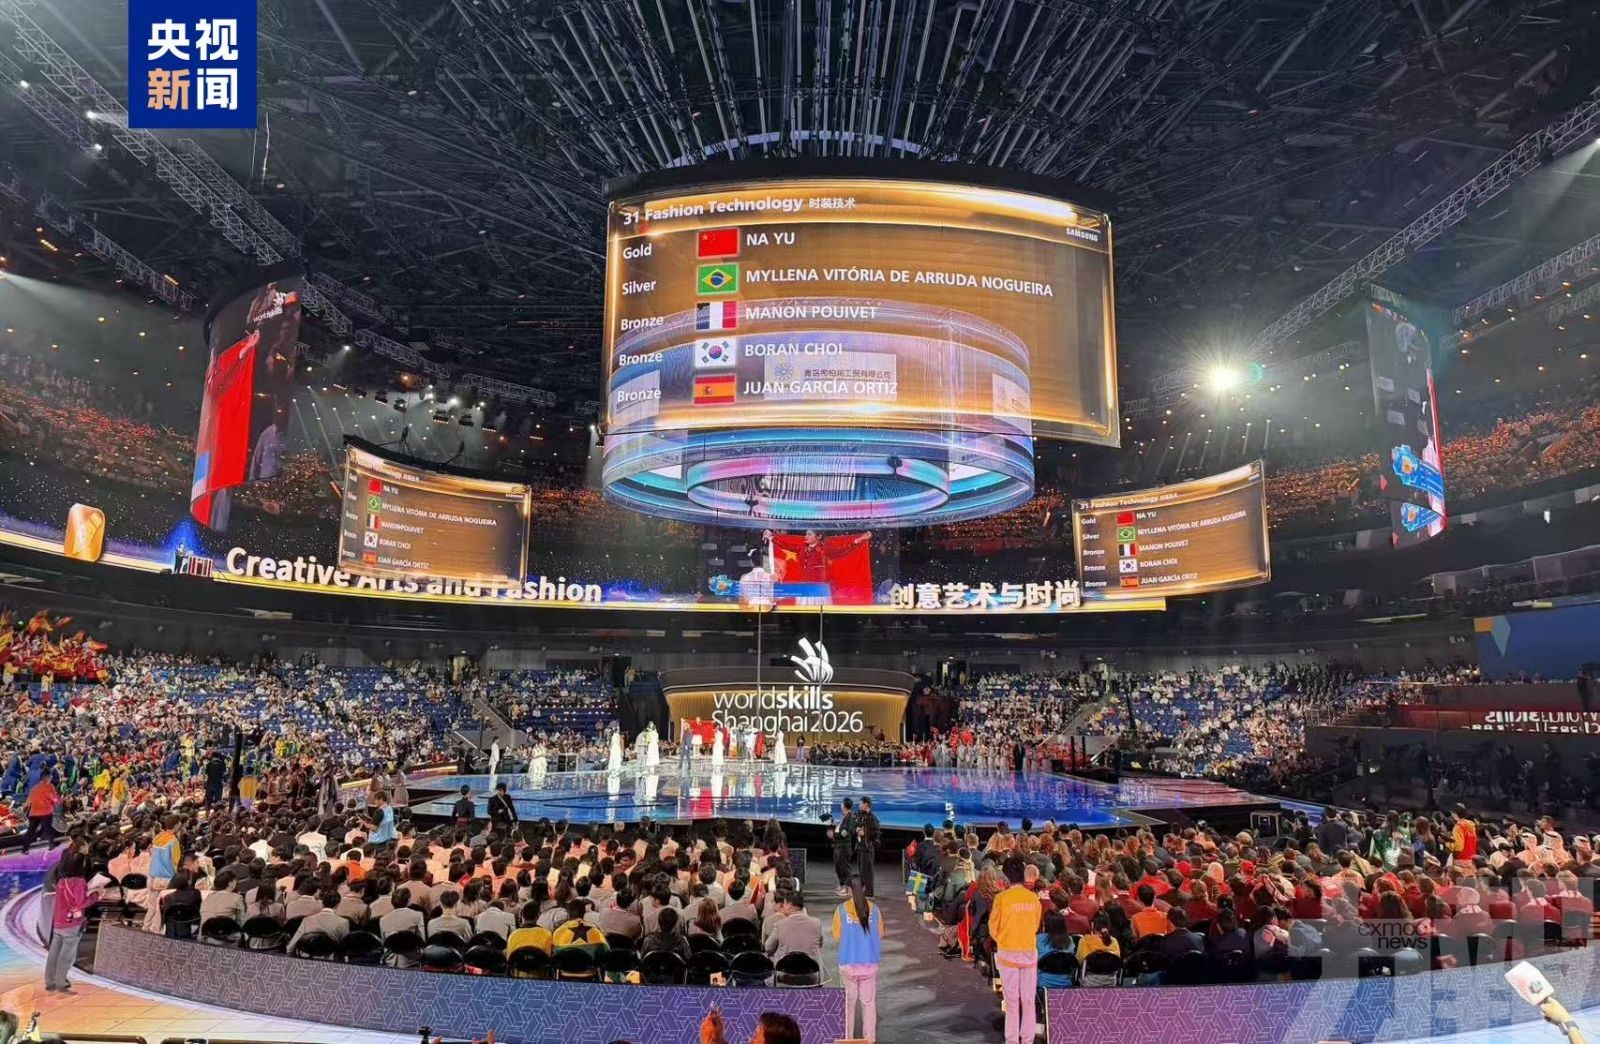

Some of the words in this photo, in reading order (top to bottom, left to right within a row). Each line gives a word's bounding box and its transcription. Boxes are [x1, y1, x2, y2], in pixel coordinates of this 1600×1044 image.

[623, 211, 640, 225] 31
[645, 204, 704, 221] Fashion
[709, 196, 803, 214] Technology
[746, 233, 769, 246] NA
[773, 232, 795, 245] YU
[1066, 227, 1098, 242] SAMSUNG
[622, 244, 652, 260] Gold
[622, 279, 657, 295] Silver
[746, 268, 819, 283] MYLLENA
[823, 266, 885, 282] VITÓRIA
[890, 270, 910, 283] DE
[914, 271, 978, 288] ARRUDA
[982, 276, 1053, 297] NOGUEIRA
[745, 306, 807, 320] MANON
[811, 305, 878, 320] POUIVET
[620, 314, 664, 331] Bronze
[745, 343, 799, 357] BORAN
[804, 343, 843, 356] CHOI
[619, 351, 663, 366] Bronze
[617, 387, 662, 402] Bronze
[743, 381, 784, 395] JUAN
[790, 378, 848, 394] GARCÍA
[853, 382, 898, 395] ORTIZ
[1081, 517, 1096, 525] Gold
[226, 547, 351, 587] Creative
[891, 580, 1081, 610] 创意艺术与时尚
[712, 685, 834, 710] worldskills
[711, 709, 808, 738] Shanghai
[811, 710, 863, 734] 2026
